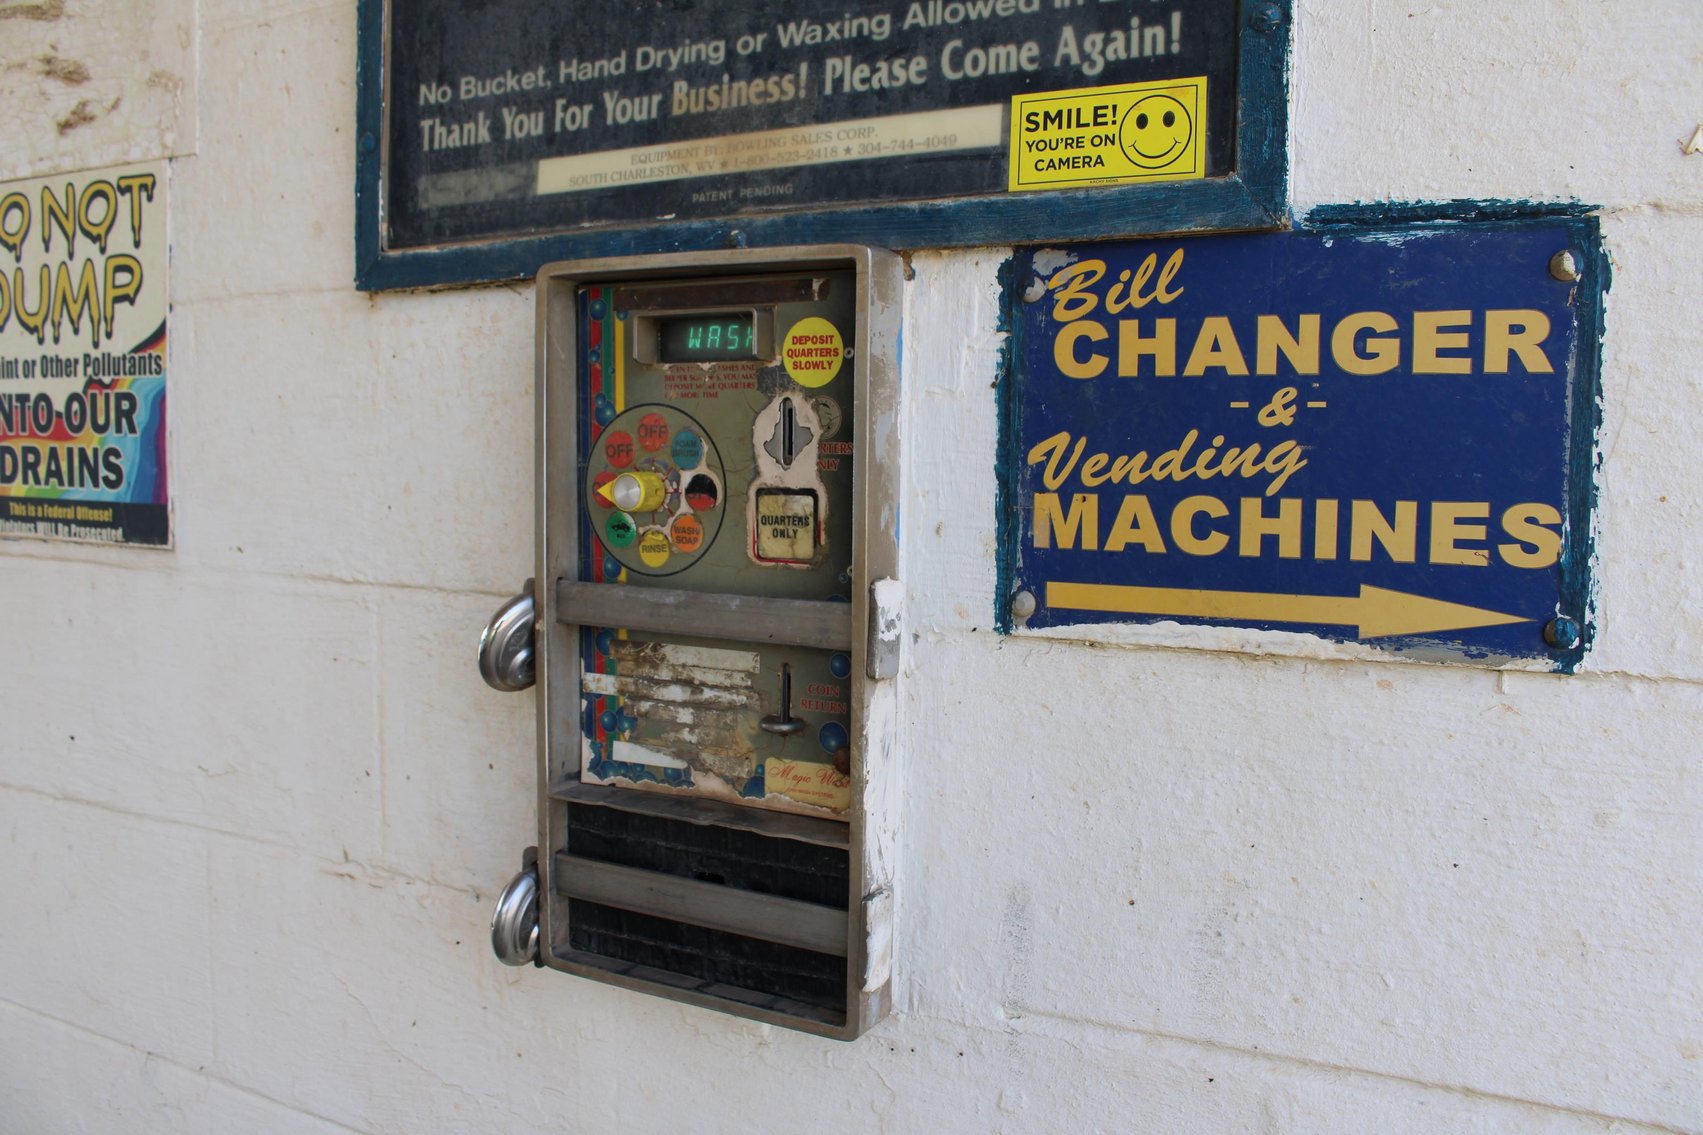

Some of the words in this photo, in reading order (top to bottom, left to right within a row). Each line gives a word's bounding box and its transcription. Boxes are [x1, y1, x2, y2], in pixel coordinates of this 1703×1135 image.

[419, 81, 451, 106] No
[459, 69, 551, 100] Bucket,
[559, 50, 626, 83] Hand
[635, 40, 726, 72] Drying
[736, 33, 767, 55] or
[777, 13, 891, 49] Waxing
[420, 111, 491, 151] Thank
[502, 106, 544, 140] You
[554, 98, 593, 133] For
[602, 90, 662, 126] Your
[671, 62, 808, 116] Business!
[824, 55, 928, 96] Please
[941, 39, 1040, 80] Come
[1054, 11, 1181, 76] Again!
[1024, 104, 1118, 133] SMILE!
[631, 147, 700, 166] EQUIPMENT
[727, 136, 787, 153] BOWLING
[791, 131, 833, 149] SALES
[836, 126, 878, 142] CORP.
[1026, 136, 1086, 152] YOU'RE
[1090, 133, 1116, 147] ON
[1034, 155, 1105, 172] CAMERA
[569, 173, 608, 188] SOUTH
[610, 164, 693, 183] CHARLESTON,
[696, 160, 716, 172] WV
[692, 190, 732, 203] PATENT
[740, 183, 794, 199] PENDING
[41, 173, 156, 261] NOT
[1047, 248, 1185, 322] Bill
[792, 335, 835, 345] DEPOSIT
[1053, 309, 1554, 380] CHANGER
[786, 347, 840, 358] QUARTERS
[0, 355, 19, 379] int
[23, 359, 37, 379] or
[40, 353, 79, 379] Other
[83, 352, 163, 378] Pollutants
[792, 360, 834, 370] SLOWLY
[0, 393, 54, 435] NTO
[64, 391, 139, 435] OUR
[638, 423, 668, 439] OFF
[606, 443, 634, 459] OFF
[818, 441, 853, 455] RTERS
[0, 445, 124, 490] DRAINS
[817, 459, 839, 471] NLY
[1028, 429, 1307, 496] Vending
[9, 501, 27, 517] This
[27, 503, 36, 518] is
[44, 503, 75, 520] Federal
[761, 515, 810, 526] QUARTERS
[1033, 492, 1562, 568] MACHINES
[674, 535, 699, 545] SOAP
[772, 528, 799, 539] ONLY
[641, 544, 667, 553] RINSE
[807, 683, 840, 697] COIN
[800, 699, 848, 713] RETURN
